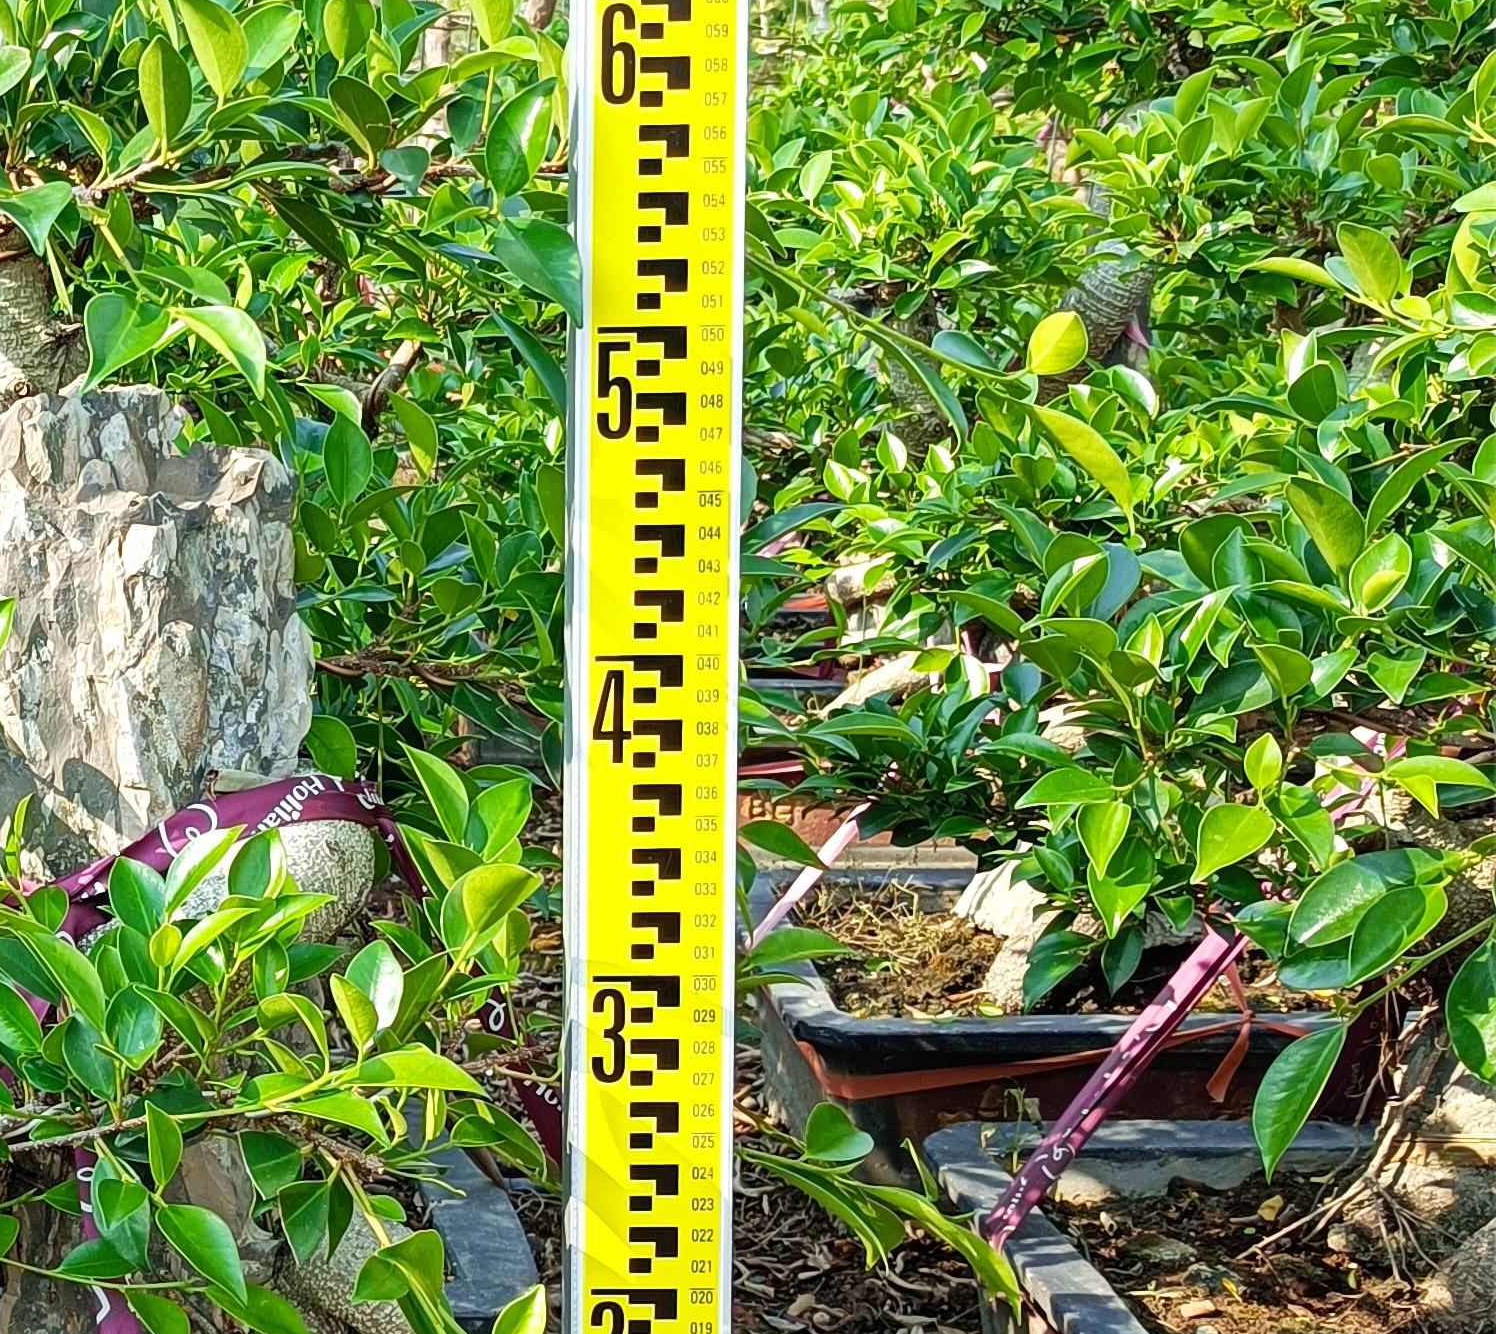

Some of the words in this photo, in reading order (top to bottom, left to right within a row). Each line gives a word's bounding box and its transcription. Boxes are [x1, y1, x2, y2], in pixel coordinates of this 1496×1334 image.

[705, 23, 729, 38] 059
[602, 3, 635, 104] 6
[704, 57, 728, 73] 058
[704, 91, 727, 107] 057
[703, 125, 727, 141] 056
[703, 159, 727, 174] 055
[702, 193, 726, 208] 054
[702, 226, 726, 242] 053
[701, 260, 725, 275] 052
[701, 294, 723, 309] 051
[701, 327, 725, 342] 050
[700, 360, 724, 376] 049
[597, 342, 632, 439] 5
[700, 393, 724, 409] 048
[699, 426, 723, 442] 047
[699, 460, 722, 475] 046
[698, 493, 722, 508] 045
[698, 525, 721, 541] 044
[697, 558, 721, 574] 043
[697, 591, 721, 606] 042
[697, 624, 719, 638] 041
[696, 656, 720, 671] 040
[696, 688, 720, 704] 039
[593, 670, 632, 763] 4
[696, 721, 719, 736] 038
[695, 753, 719, 768] 037
[695, 786, 718, 800] 036
[695, 818, 718, 832] 035
[694, 850, 717, 864] 034
[694, 882, 717, 896] 033
[694, 913, 717, 928] 032
[693, 945, 715, 960] 031
[693, 977, 717, 992] 030
[693, 1008, 716, 1023] 029
[592, 989, 625, 1083] 3
[692, 1040, 716, 1055] 028
[692, 1072, 715, 1086] 027
[692, 1103, 715, 1118] 026
[692, 1134, 715, 1149] 025
[691, 1166, 714, 1181] 024
[691, 1197, 715, 1212] 023
[691, 1228, 714, 1243] 022
[690, 1259, 712, 1274] 021
[690, 1290, 714, 1305] 020
